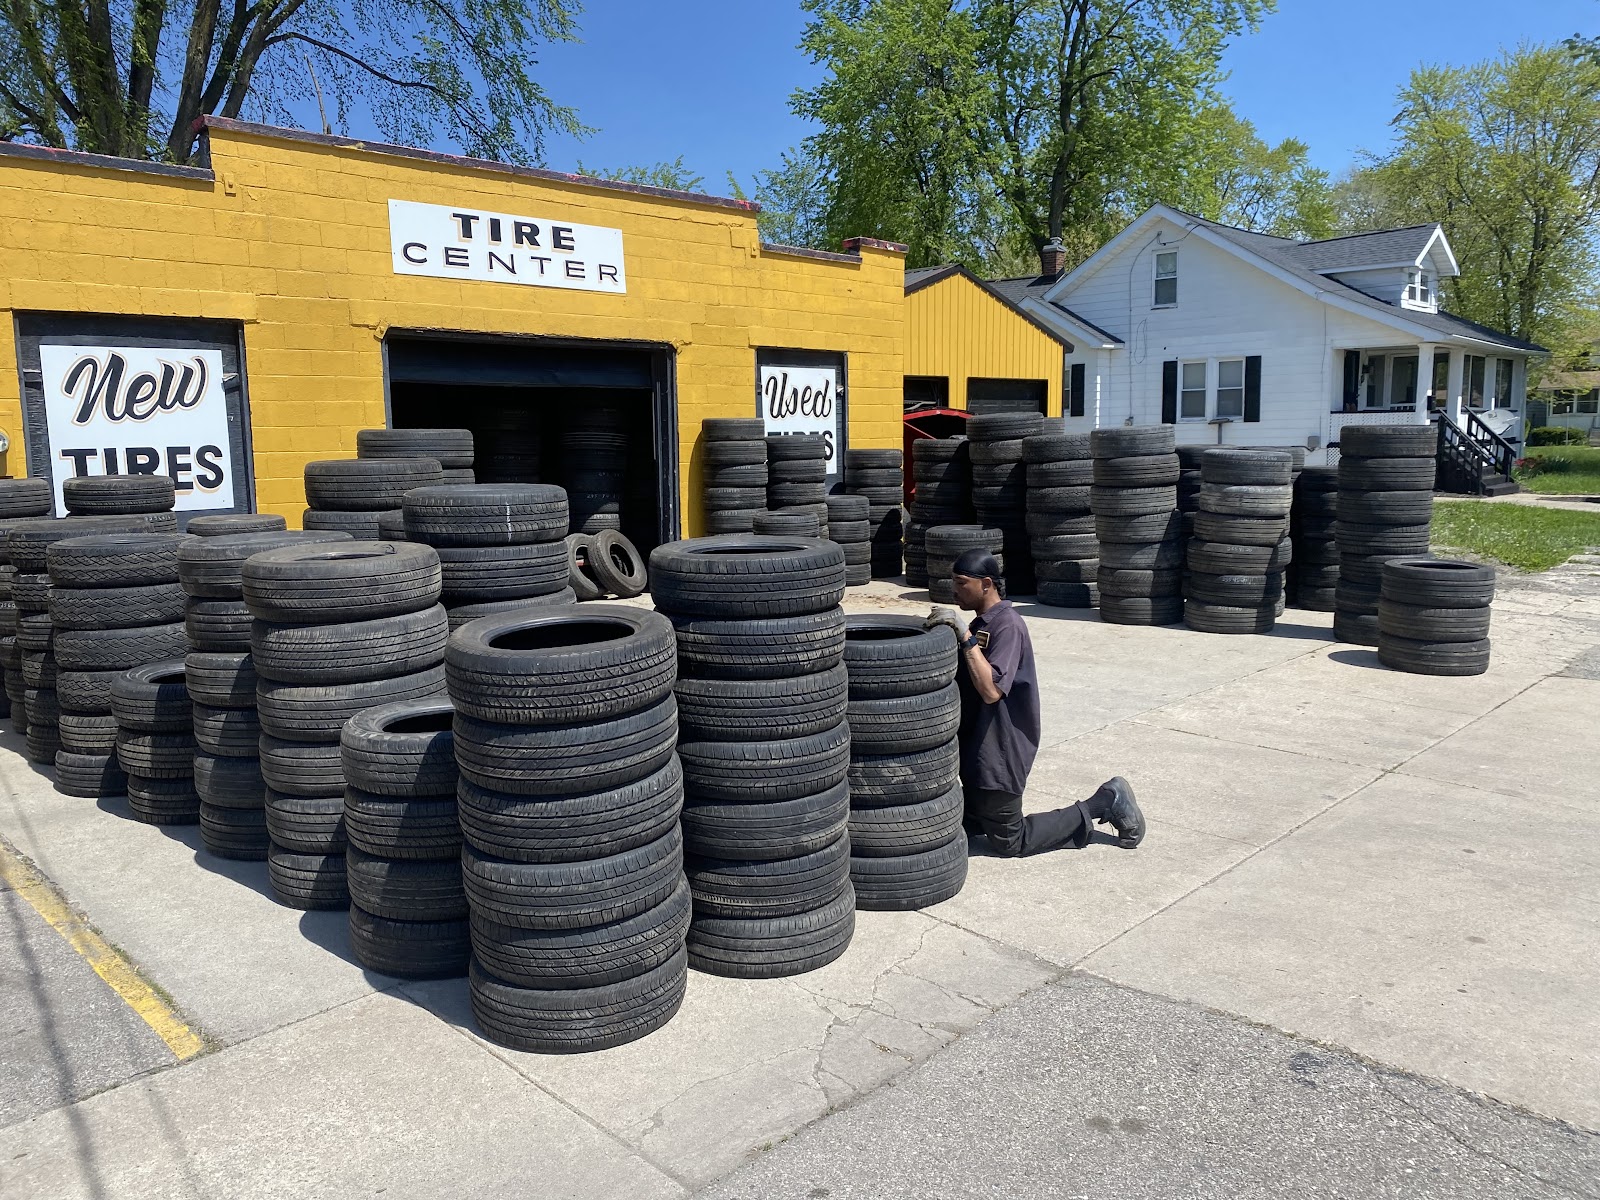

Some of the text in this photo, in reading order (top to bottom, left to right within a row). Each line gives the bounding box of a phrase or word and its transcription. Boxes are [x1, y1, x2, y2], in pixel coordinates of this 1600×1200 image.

[452, 212, 576, 251] TIRE
[402, 241, 619, 284] CENTER
[62, 351, 208, 425] New
[765, 372, 832, 419] Used
[60, 444, 224, 490] TIRES
